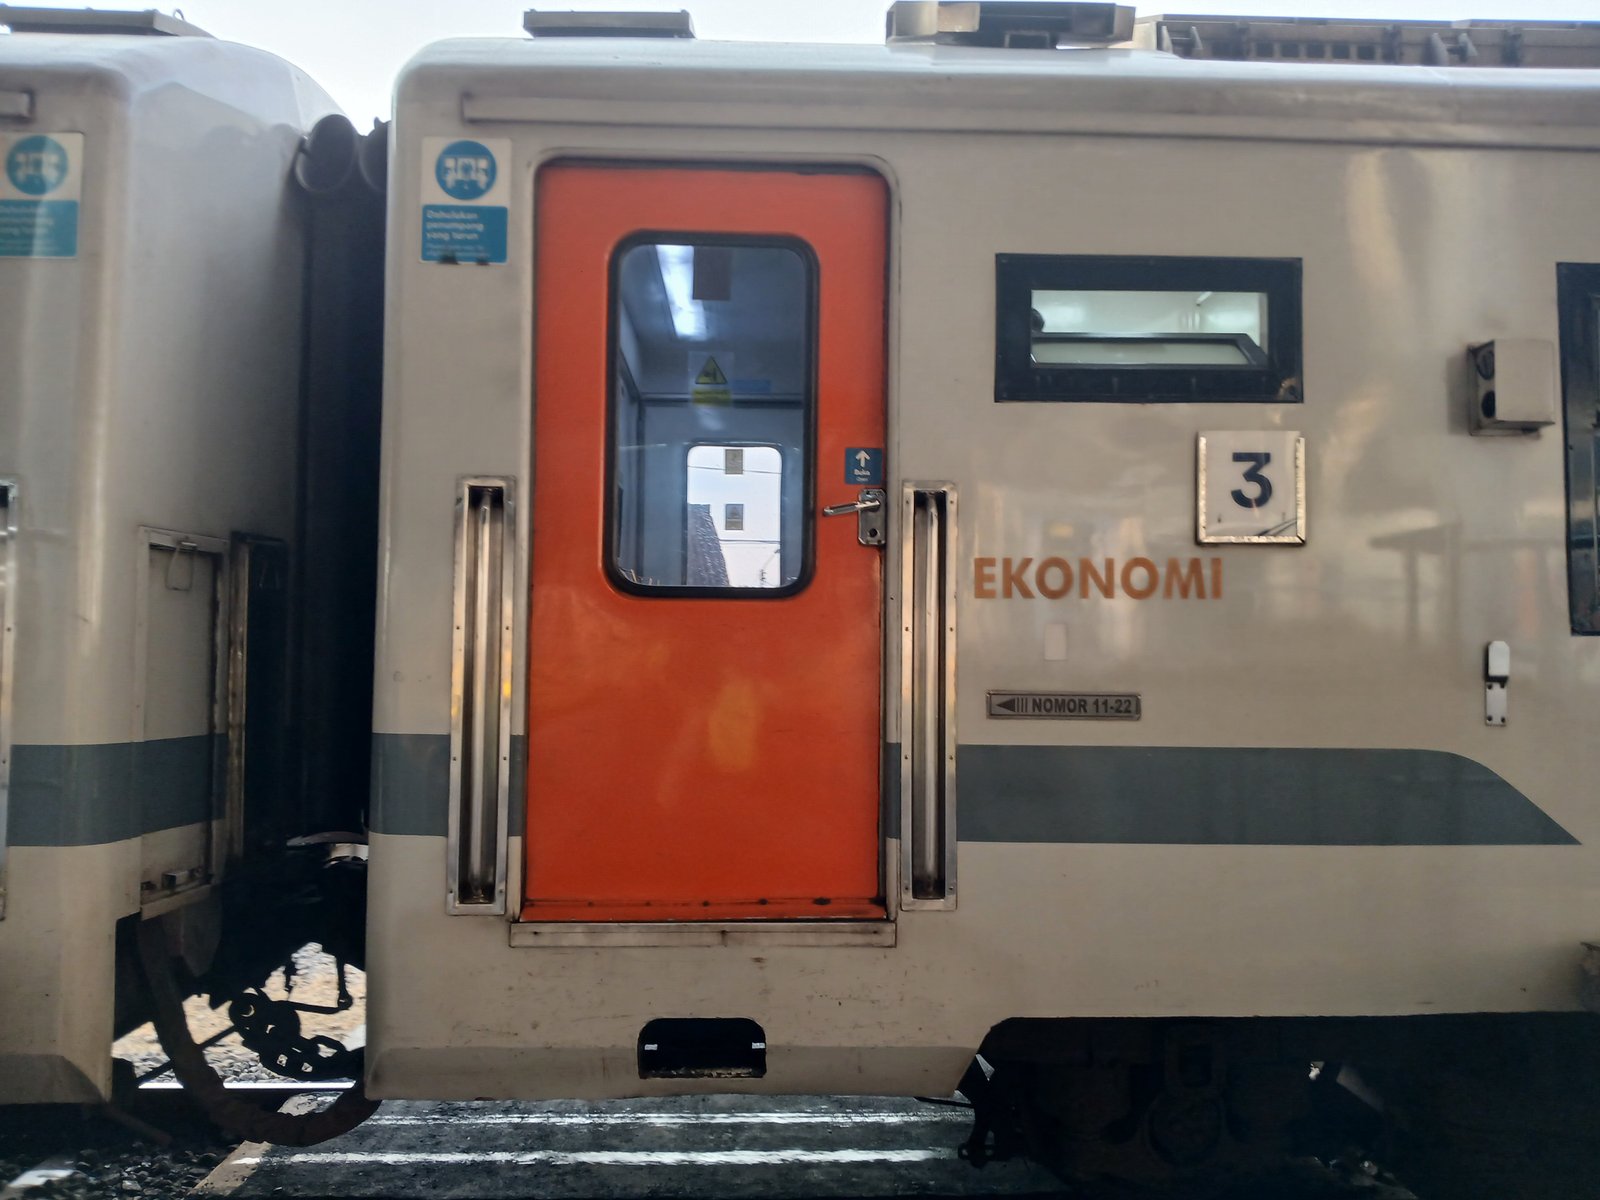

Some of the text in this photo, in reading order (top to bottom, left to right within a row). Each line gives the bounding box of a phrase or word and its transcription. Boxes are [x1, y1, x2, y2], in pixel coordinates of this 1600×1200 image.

[1231, 452, 1273, 509] 3
[974, 557, 1222, 600] EKONOMI
[1031, 697, 1132, 714] NOMOR 11-22
